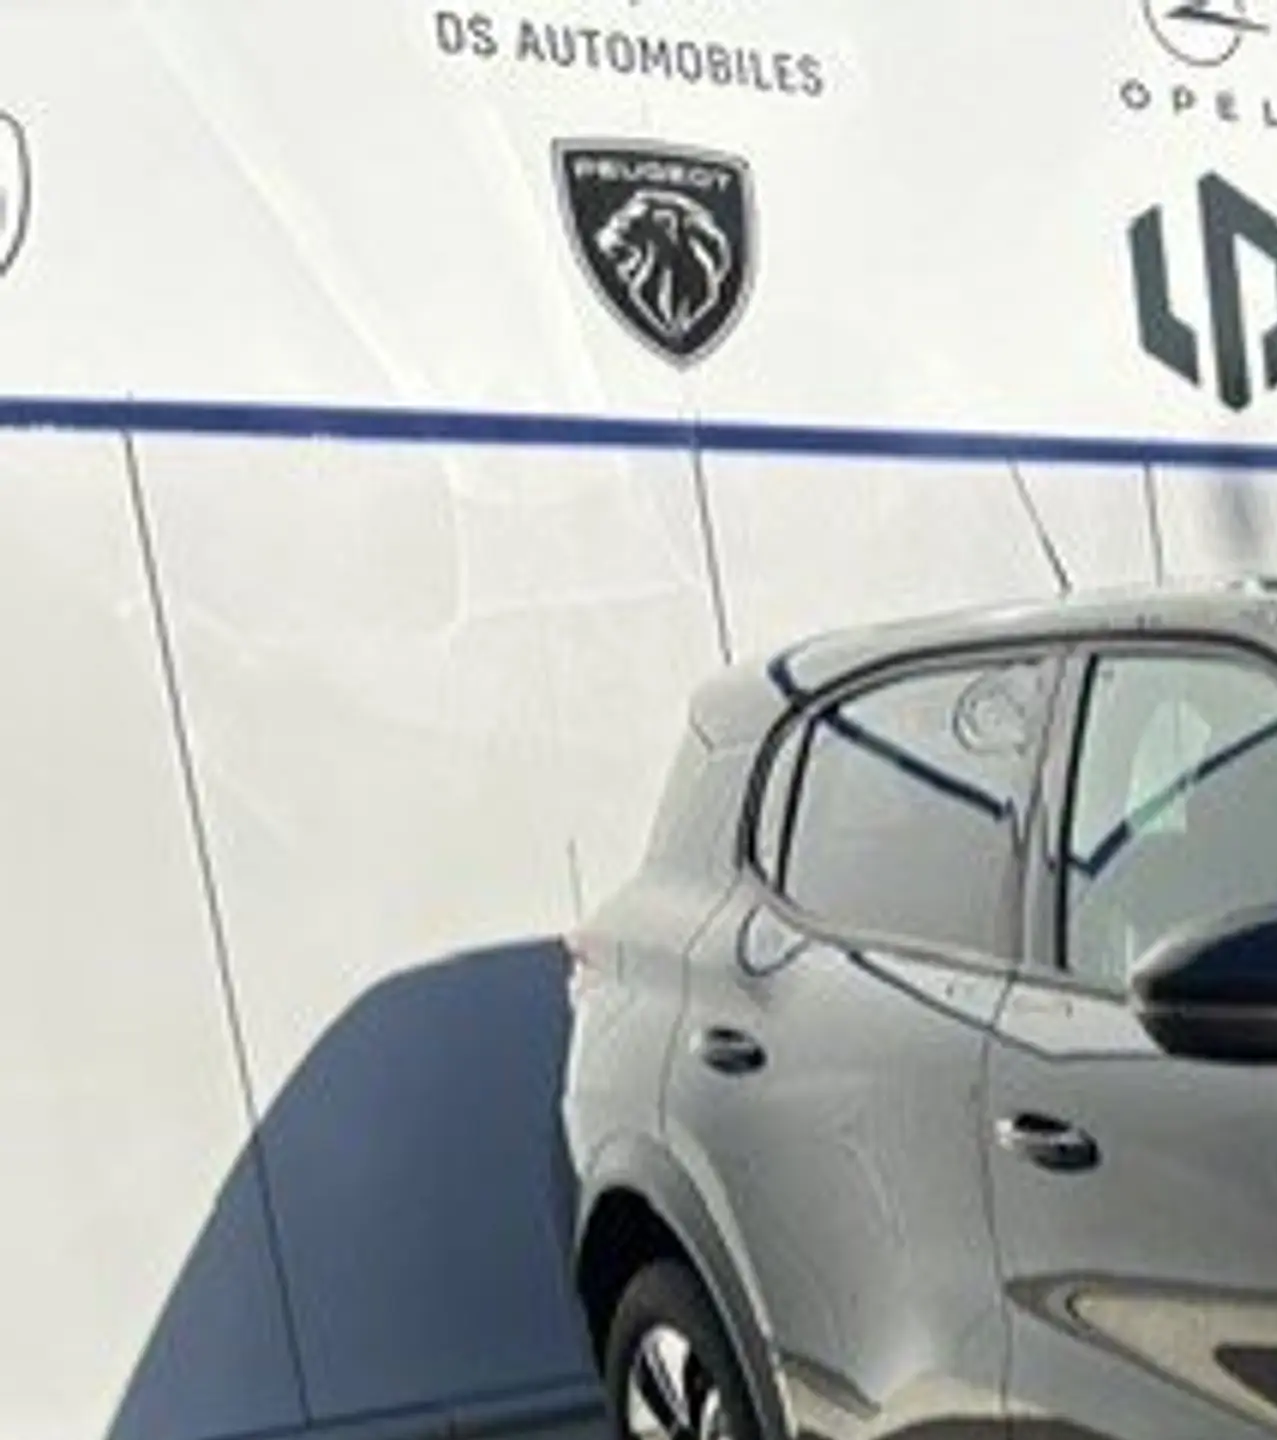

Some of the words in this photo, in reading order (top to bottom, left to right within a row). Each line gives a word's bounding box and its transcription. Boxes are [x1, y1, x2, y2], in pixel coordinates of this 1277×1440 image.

[435, 10, 499, 58] DS
[515, 17, 824, 98] AUTOMOBILES
[573, 156, 733, 193] PEUGEOT
